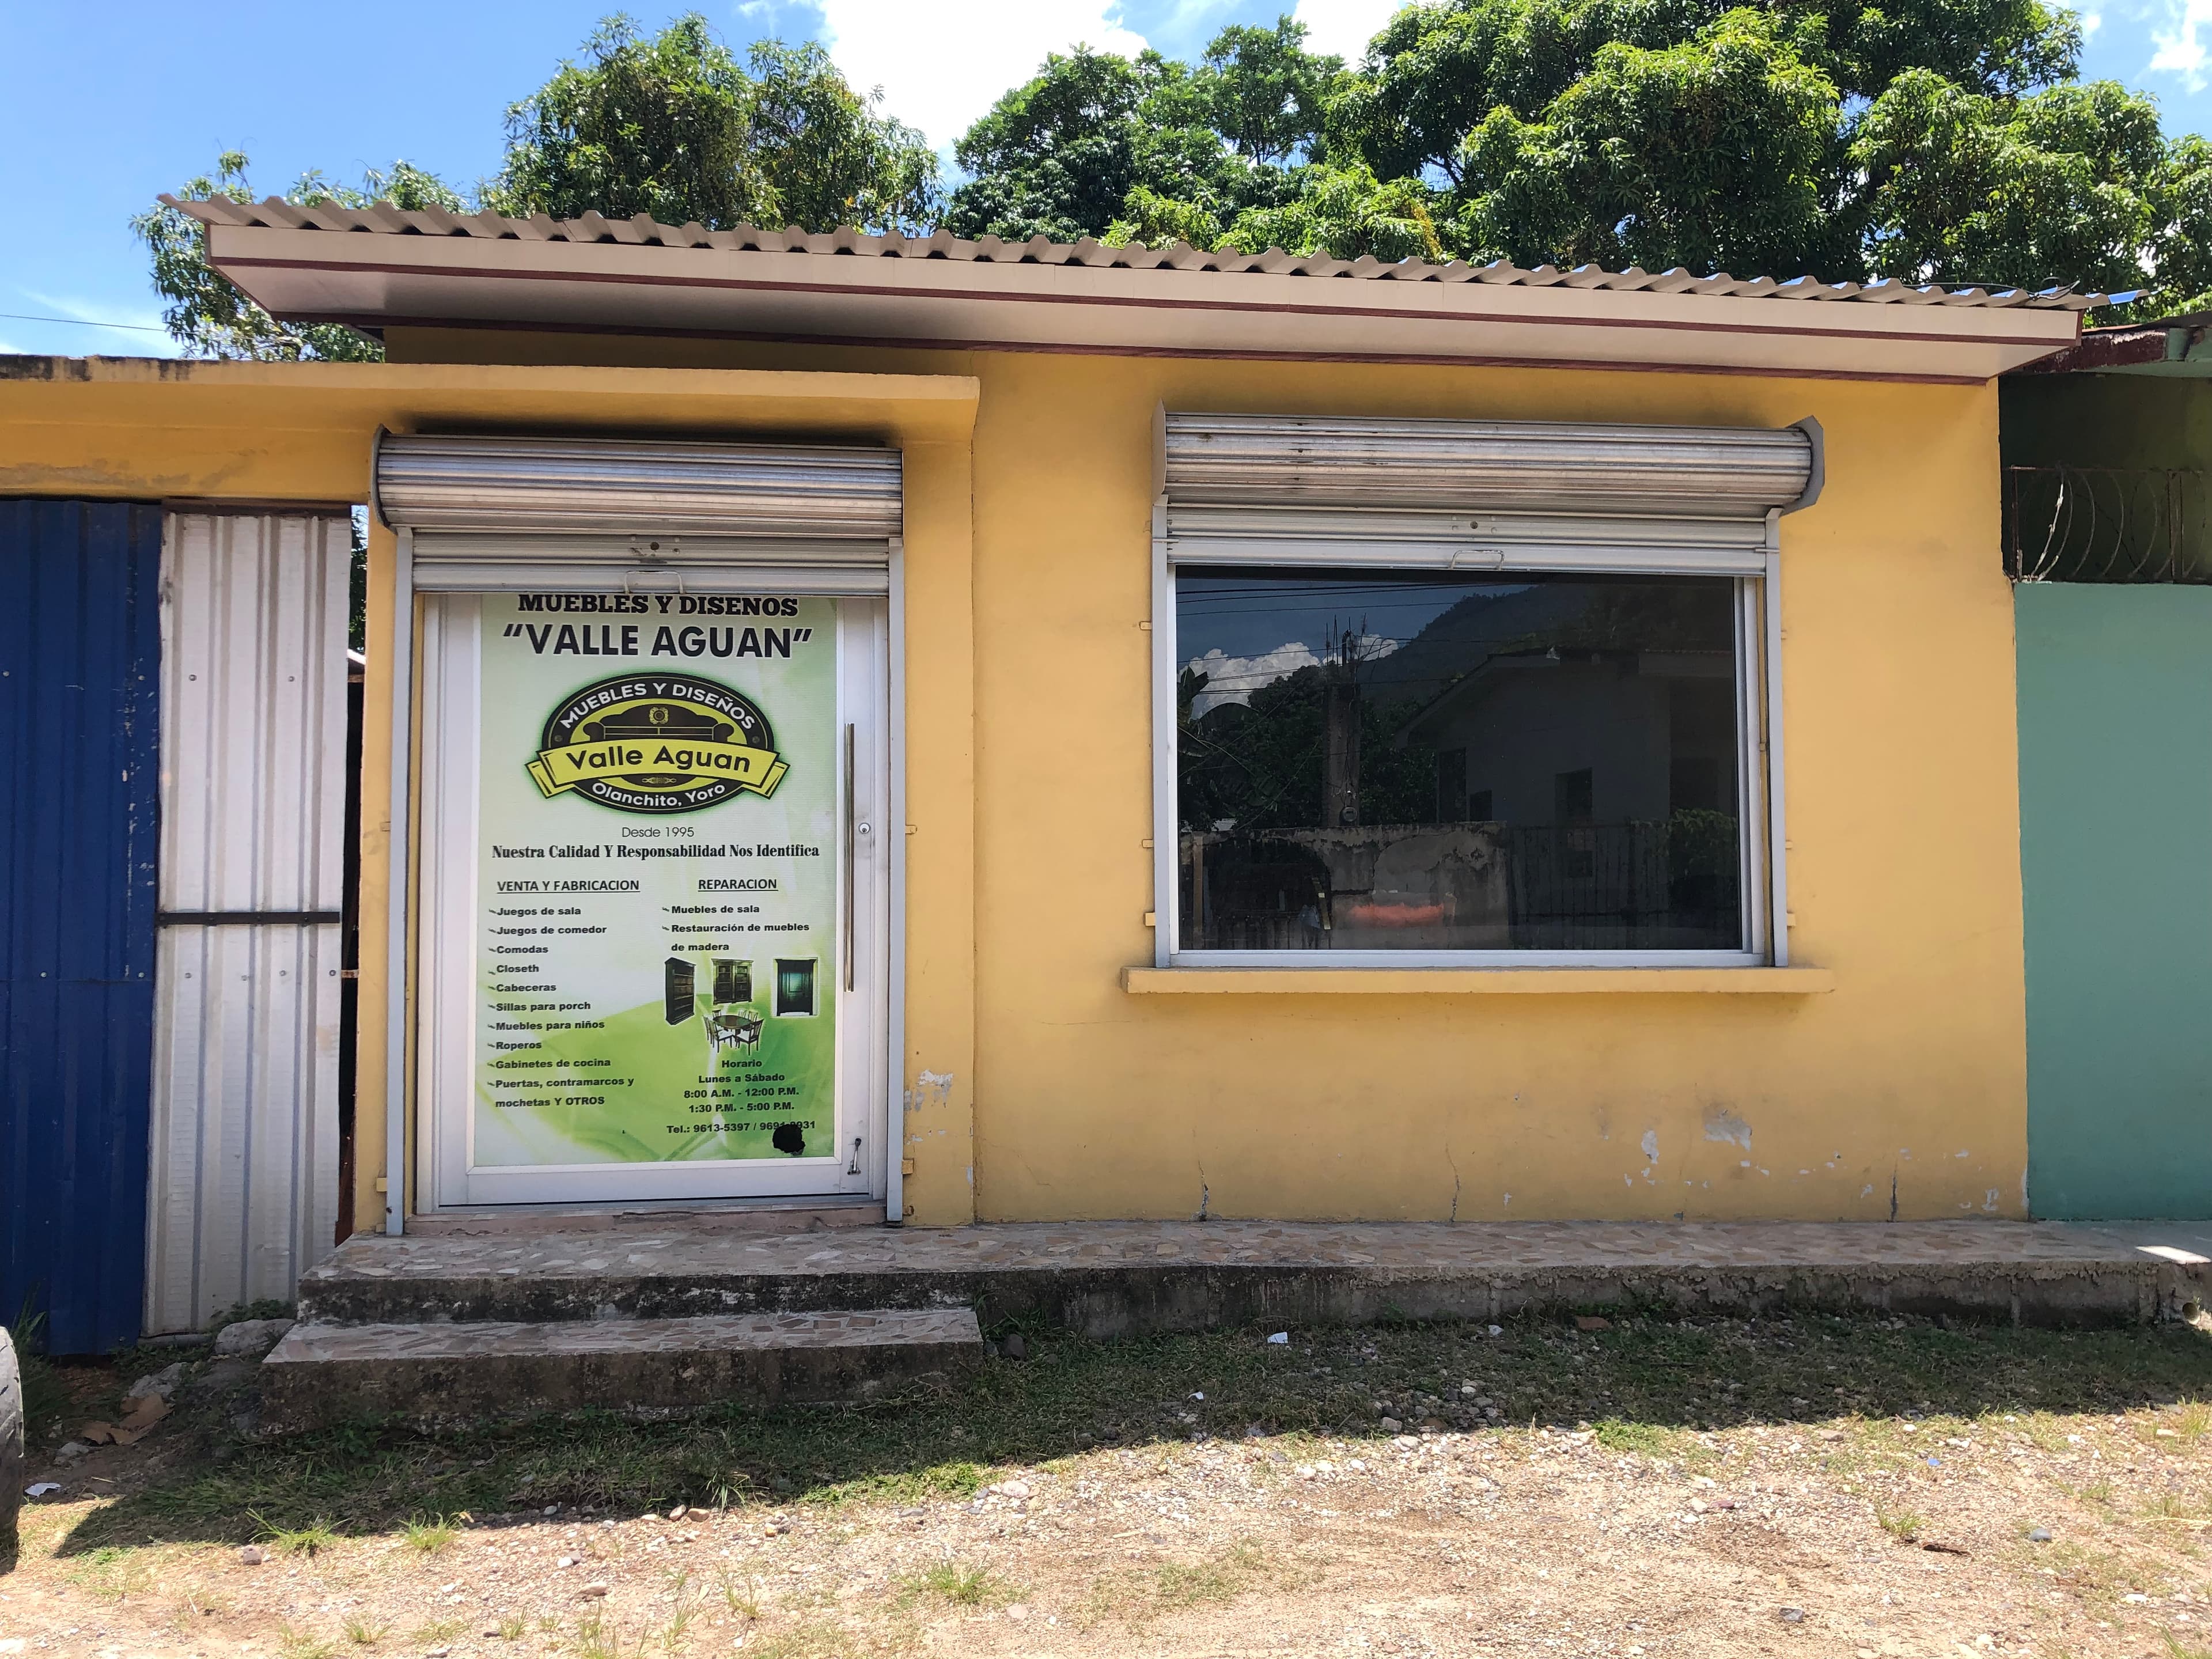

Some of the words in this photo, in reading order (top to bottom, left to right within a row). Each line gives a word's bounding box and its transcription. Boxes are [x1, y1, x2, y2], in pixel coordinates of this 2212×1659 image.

[518, 594, 649, 613] MUEBLES
[655, 596, 675, 614] Y
[559, 683, 647, 729] MUEBLES
[653, 683, 667, 695] Y
[672, 684, 756, 729] DISEÑOS
[566, 746, 643, 770] Valle
[653, 745, 751, 772] Aguan
[592, 782, 682, 806] Olanchito,
[685, 784, 726, 803] Yoro
[622, 827, 661, 837] Desde
[665, 827, 694, 837] 1995
[492, 845, 545, 858] Nuestra
[549, 845, 600, 858] Calidad
[604, 845, 613, 858] Y
[617, 844, 725, 861] Responsabilidad
[729, 844, 752, 857] Nos
[756, 844, 820, 857] Identifica
[497, 881, 539, 891] VENTA
[542, 881, 550, 891] Y
[554, 880, 639, 891] FABRICACION
[698, 879, 777, 889] REPARACION
[497, 908, 537, 917] Juegos
[672, 906, 717, 914] Muebles
[737, 905, 760, 913] sala
[497, 927, 537, 936] Juegos
[558, 926, 607, 934] comedor
[672, 924, 744, 932] Restauración
[747, 923, 760, 931] de
[764, 923, 809, 931] muebles
[497, 945, 548, 954] Comodas
[688, 943, 729, 951] madera
[497, 964, 539, 973] Closeth
[496, 983, 556, 992] Cabeceras
[496, 1003, 527, 1012] Sillas
[530, 1003, 556, 1012] para
[559, 1002, 591, 1012] porch
[496, 1022, 543, 1031] Muebles
[546, 1022, 571, 1031] para
[574, 1021, 605, 1029] niños
[496, 1041, 542, 1051] Roperos
[496, 1060, 553, 1069] Gabinetes
[556, 1059, 570, 1067] de
[573, 1059, 611, 1067] cocina
[722, 1059, 762, 1068] Horario
[496, 1080, 543, 1089] Puertas,
[546, 1077, 624, 1087] contramarcos
[627, 1078, 634, 1086] y
[699, 1075, 732, 1083] Lunes
[744, 1073, 785, 1082] Sábado
[684, 1090, 707, 1098] 8:00
[710, 1089, 734, 1097] A.M.
[744, 1088, 774, 1097] 12:00
[778, 1087, 799, 1095] P.M.
[495, 1099, 551, 1108] mochetas
[554, 1097, 562, 1105] Y
[566, 1096, 605, 1105] OTROS
[688, 1105, 711, 1113] 1:30
[715, 1104, 737, 1112] P.M.
[747, 1103, 770, 1111] 5:00
[774, 1102, 794, 1110] P.M.
[666, 1125, 690, 1134] Tel.:
[694, 1123, 750, 1132] 9613-5397
